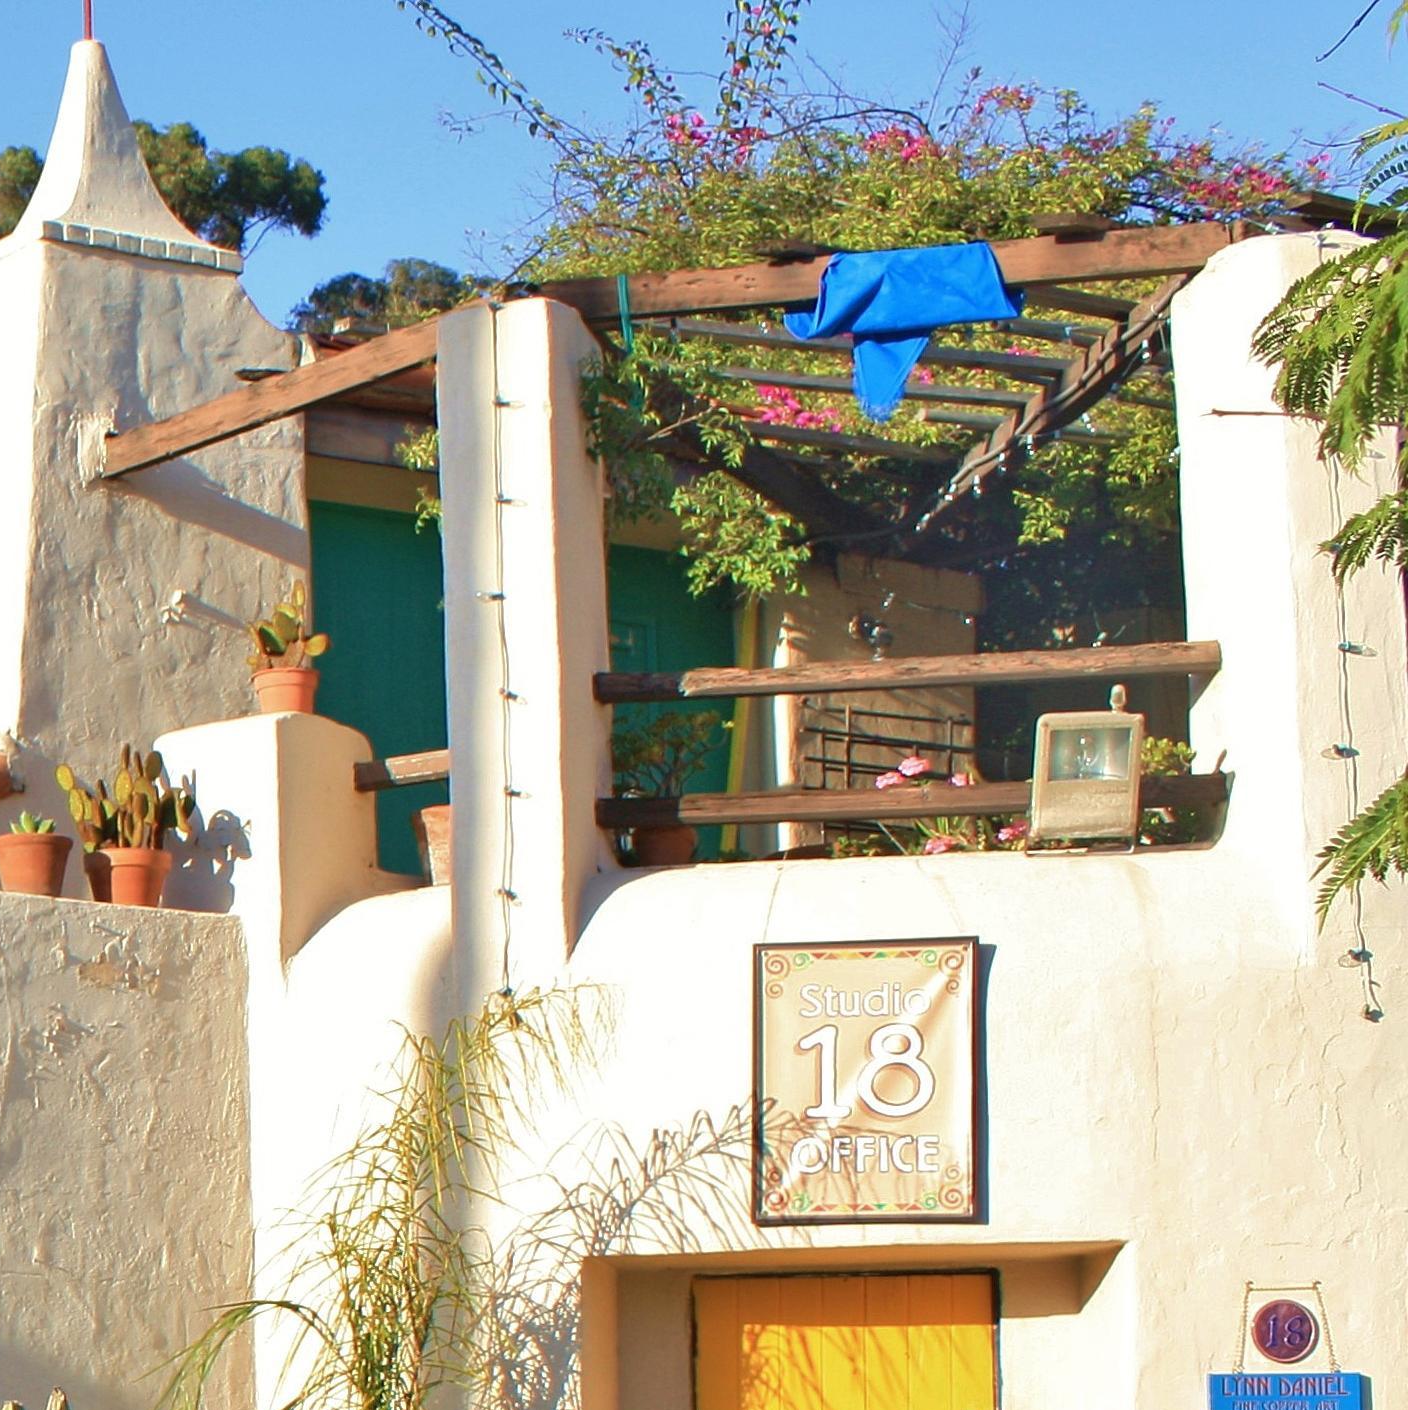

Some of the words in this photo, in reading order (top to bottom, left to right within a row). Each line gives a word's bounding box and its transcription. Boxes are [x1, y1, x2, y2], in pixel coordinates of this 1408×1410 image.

[799, 983, 931, 1017] Studio
[798, 1023, 935, 1118] 18
[790, 1135, 940, 1174] OFFICE
[1265, 1313, 1306, 1349] 18
[1222, 1376, 1270, 1396] LYNN
[1279, 1374, 1350, 1396] DANIEL
